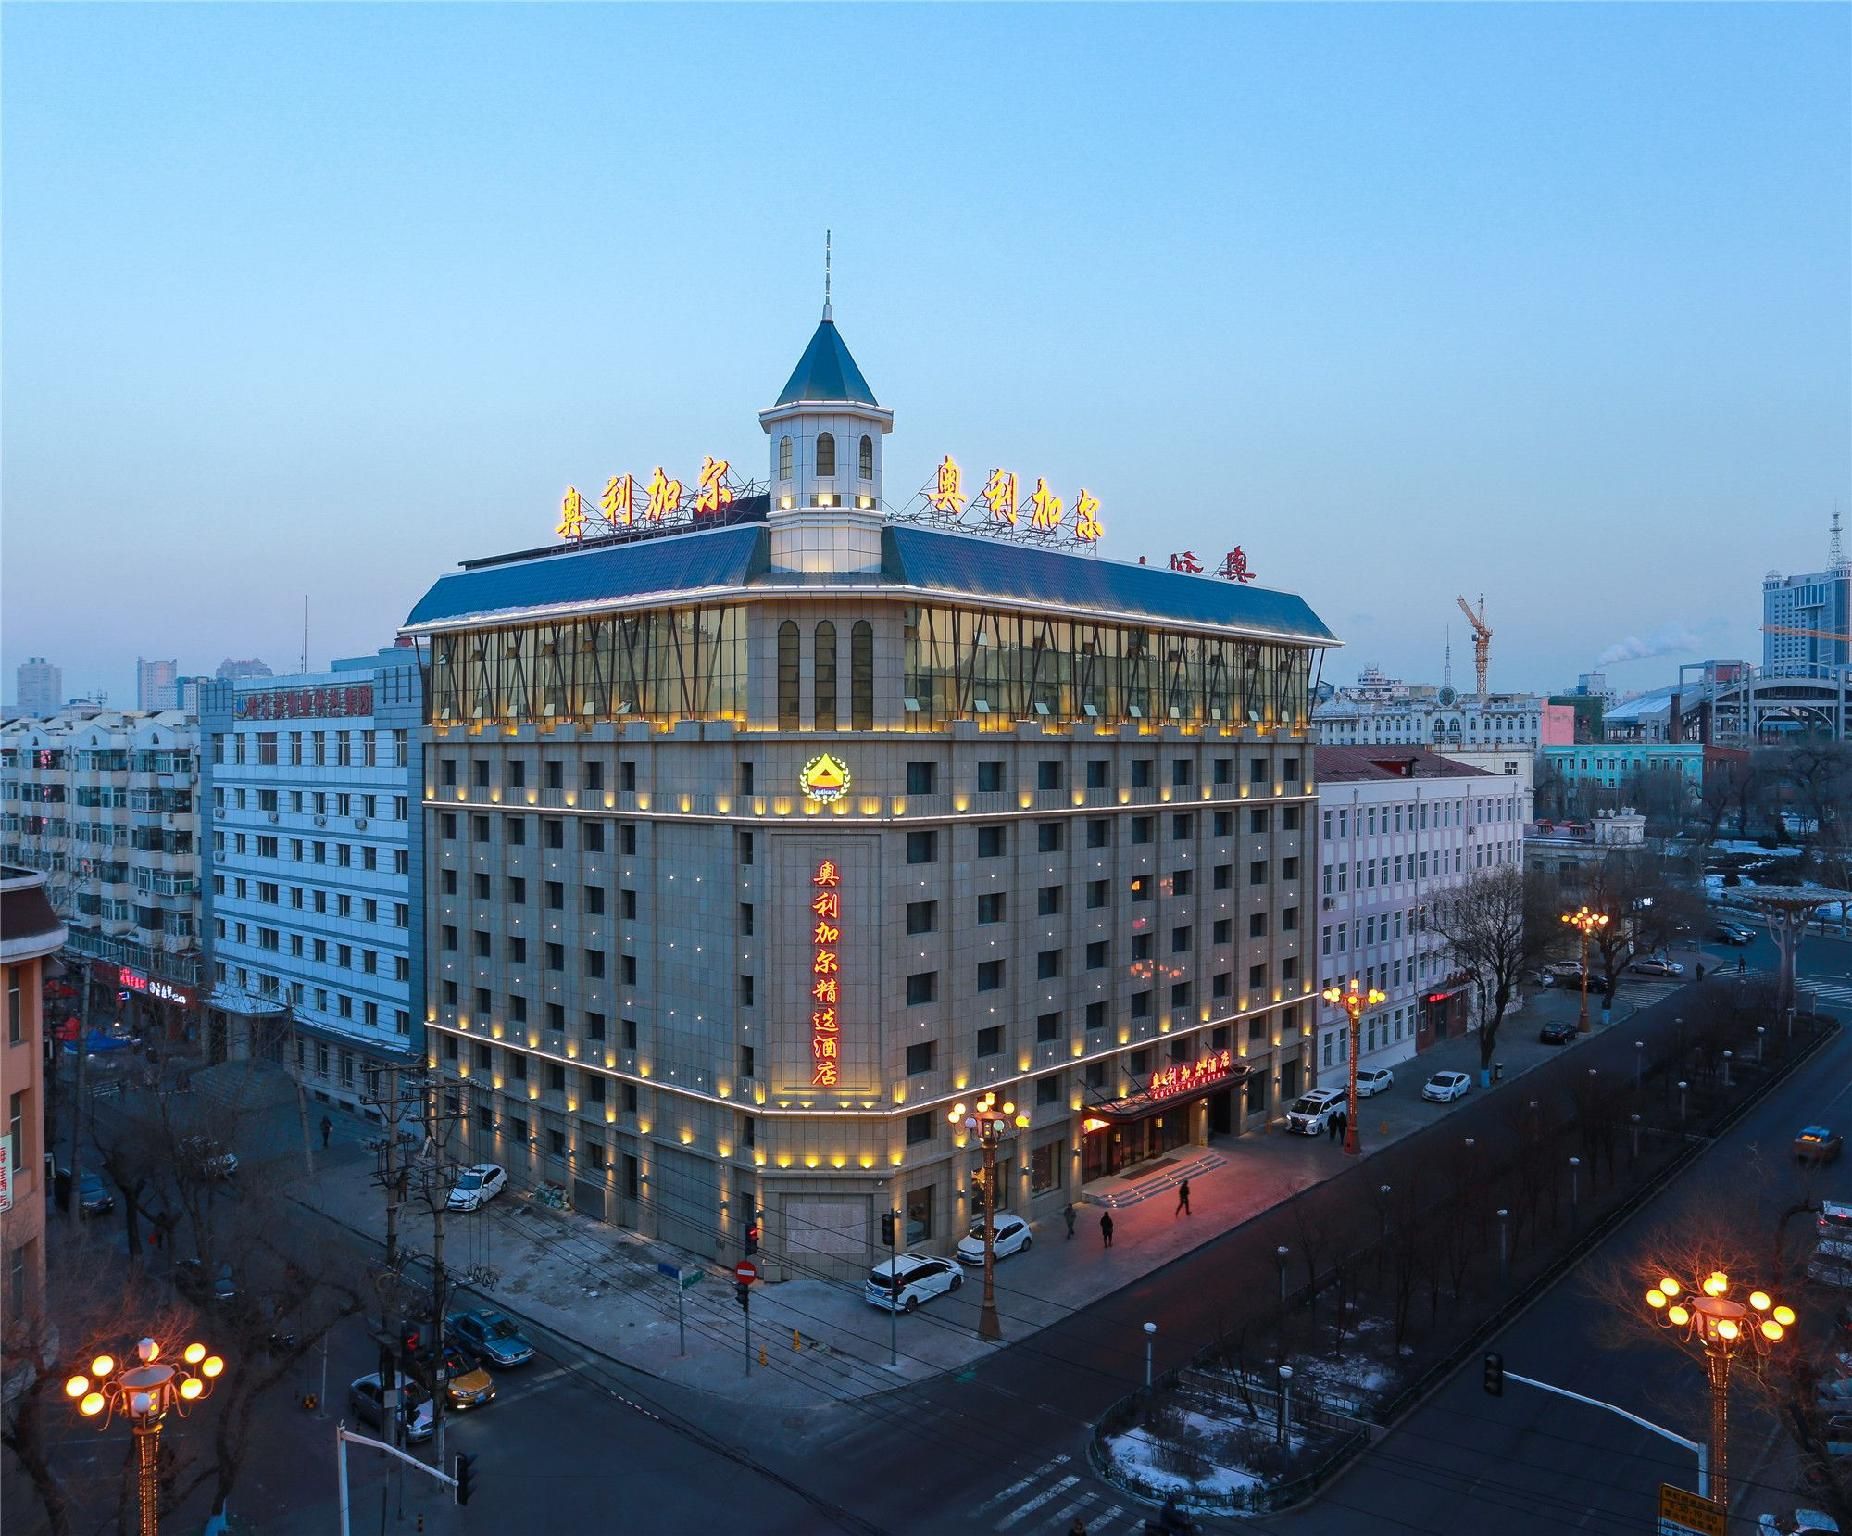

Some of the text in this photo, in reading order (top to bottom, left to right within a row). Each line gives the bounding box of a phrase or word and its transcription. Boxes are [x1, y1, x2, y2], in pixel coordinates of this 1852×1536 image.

[555, 456, 733, 539] 奥利加尔
[927, 455, 1104, 541] 奥利加尔
[812, 861, 840, 1086] 奥利加尔精选酒店
